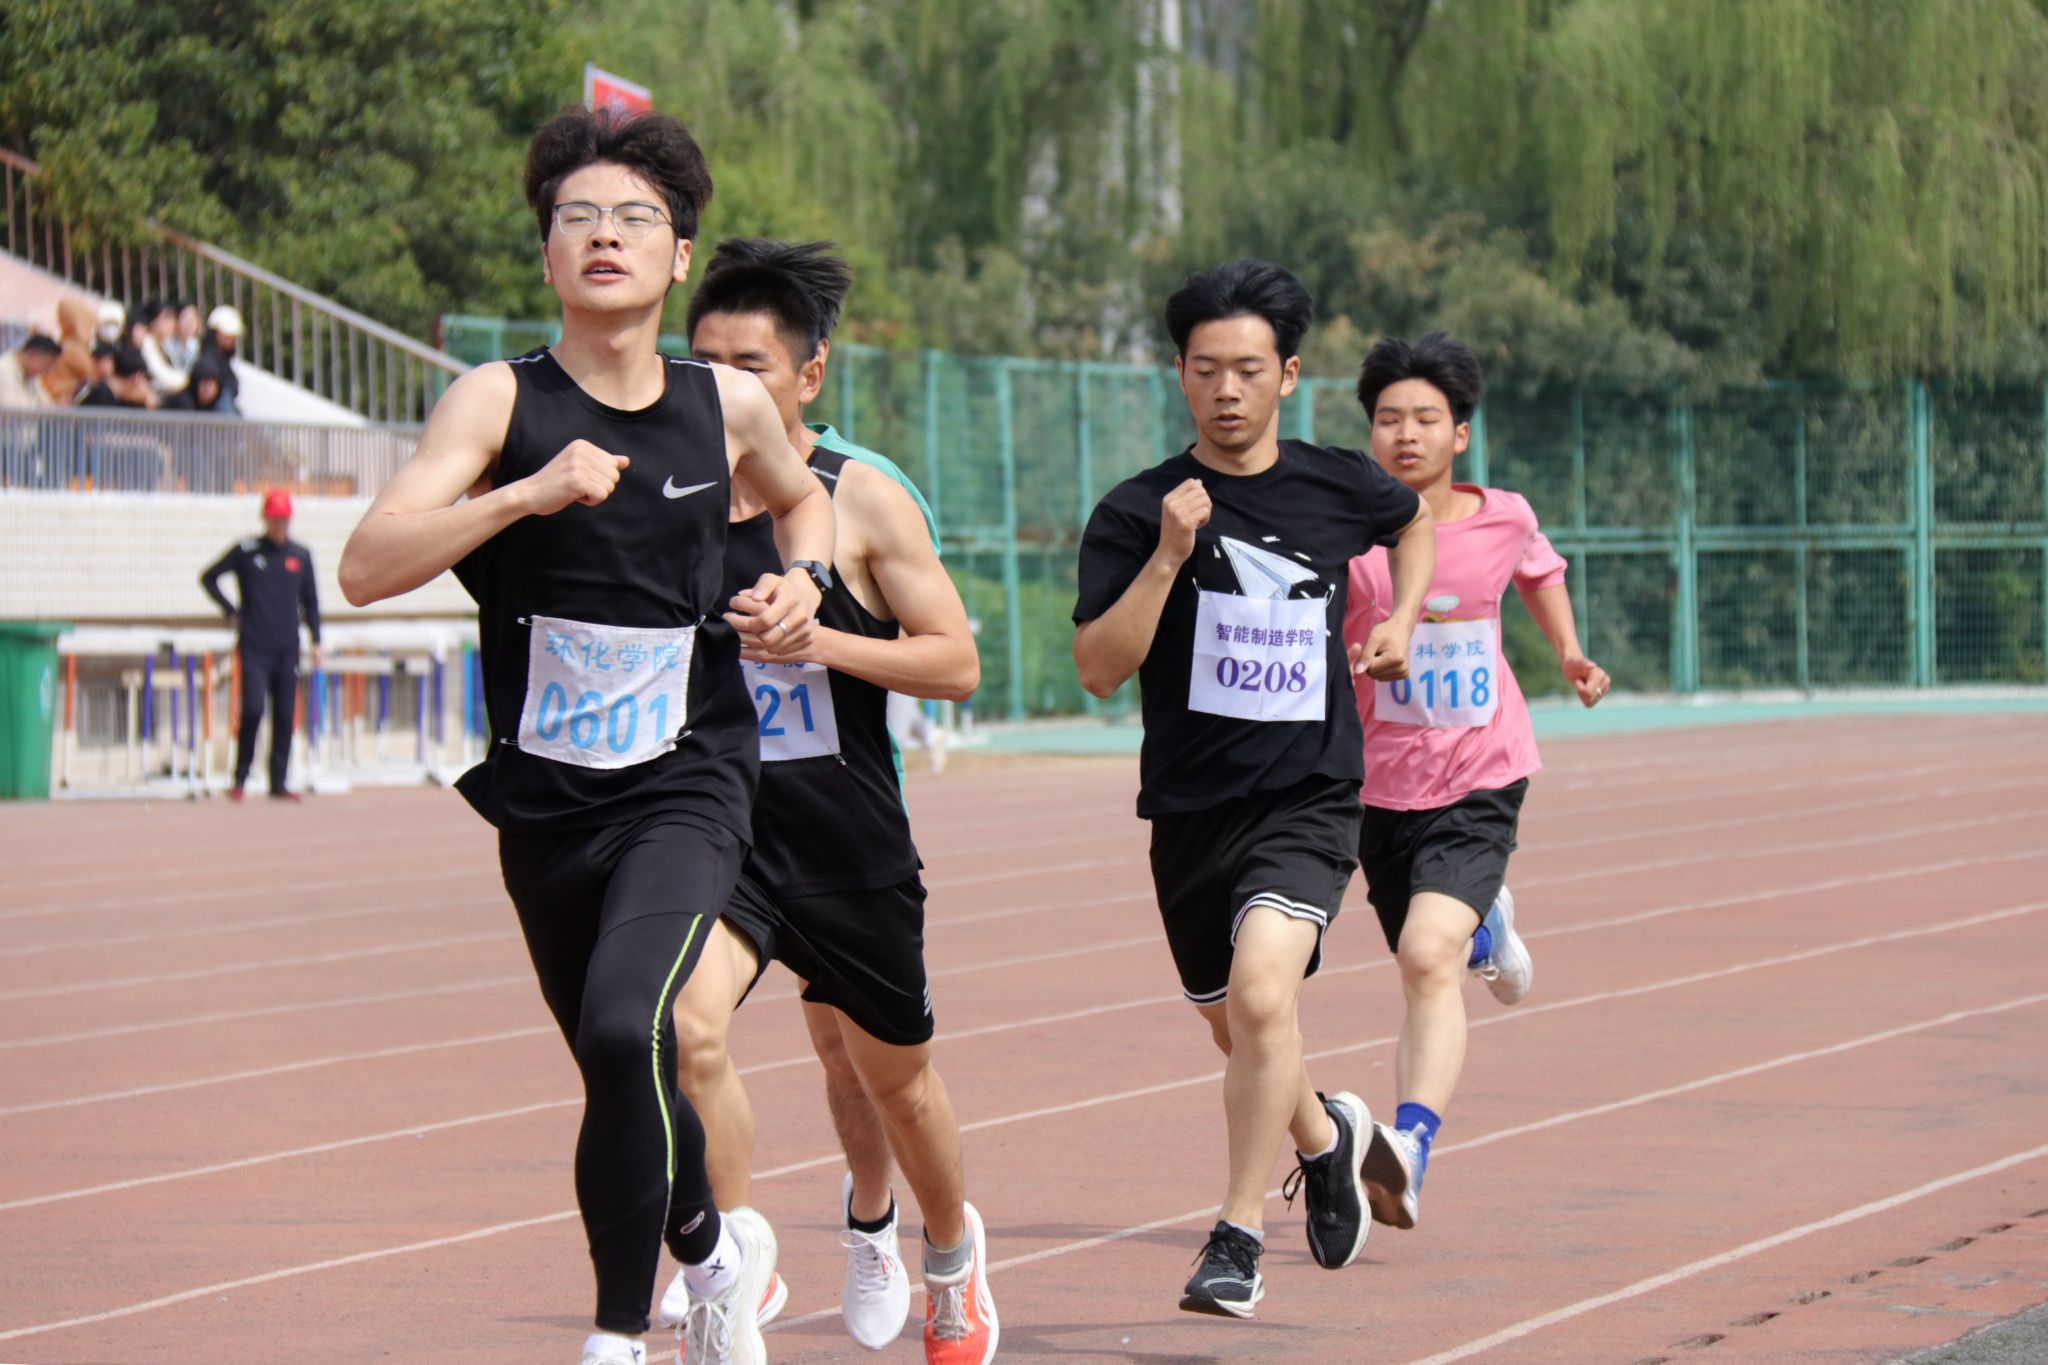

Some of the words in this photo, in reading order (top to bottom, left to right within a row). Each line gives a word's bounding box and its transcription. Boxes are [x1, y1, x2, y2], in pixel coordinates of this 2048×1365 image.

[1216, 622, 1314, 647] 智能制造学院
[1216, 657, 1307, 693] 0208
[1390, 667, 1490, 709] 0118
[536, 681, 669, 754] 0601
[754, 683, 815, 737] 21
